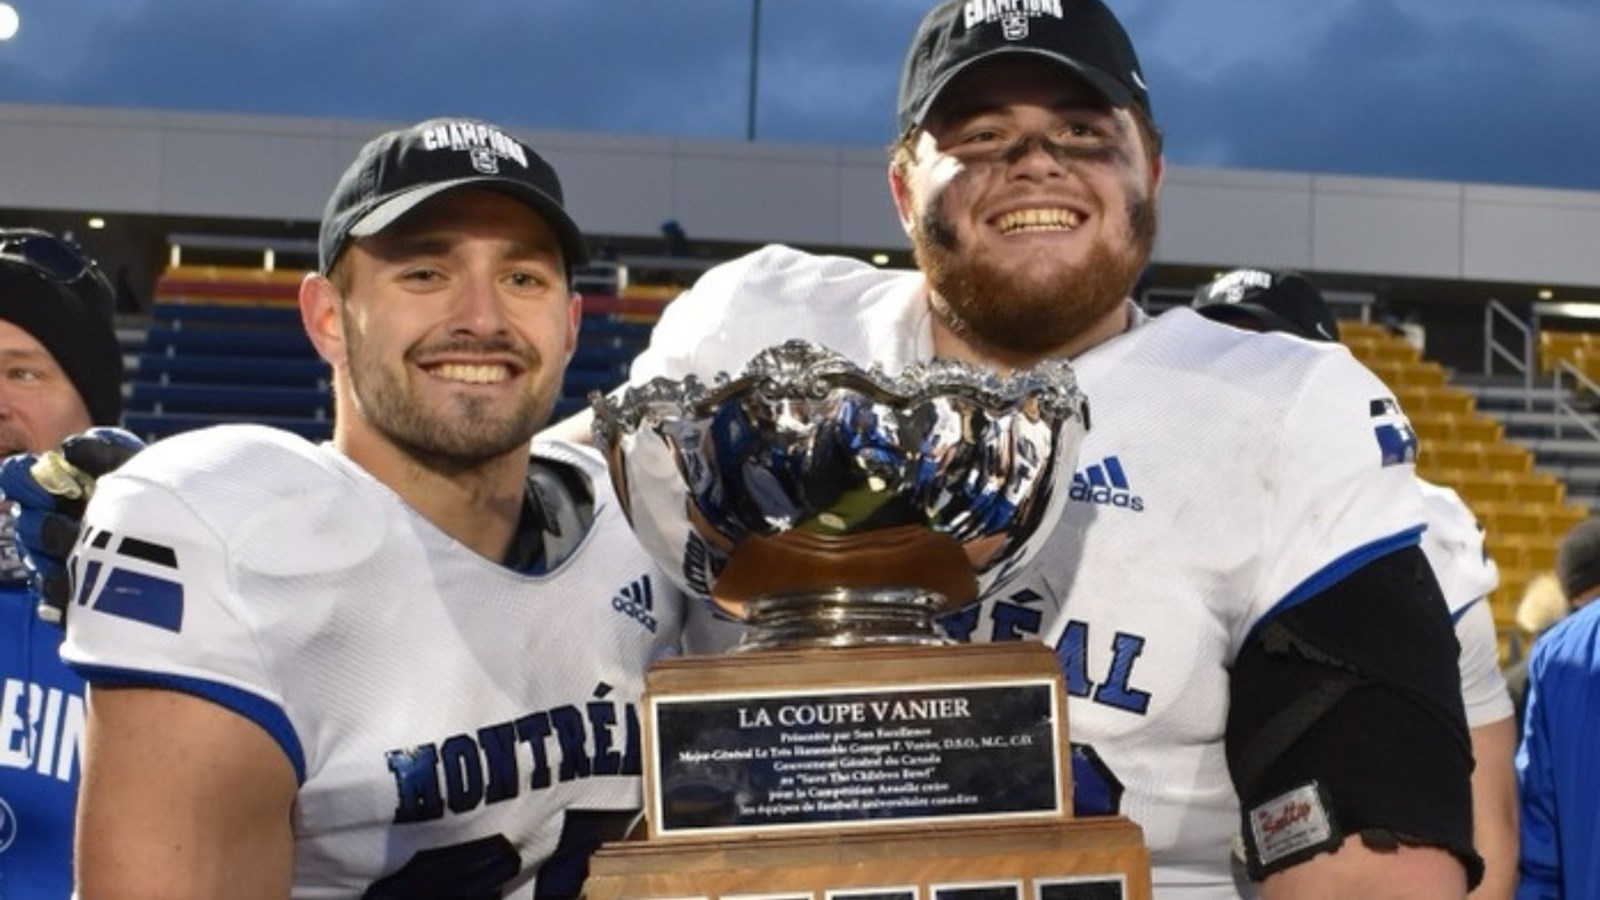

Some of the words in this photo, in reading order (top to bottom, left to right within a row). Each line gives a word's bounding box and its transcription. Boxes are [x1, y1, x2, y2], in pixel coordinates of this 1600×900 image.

[738, 707, 773, 729] LA
[778, 703, 866, 725] COUPE
[870, 698, 971, 720] VANIER
